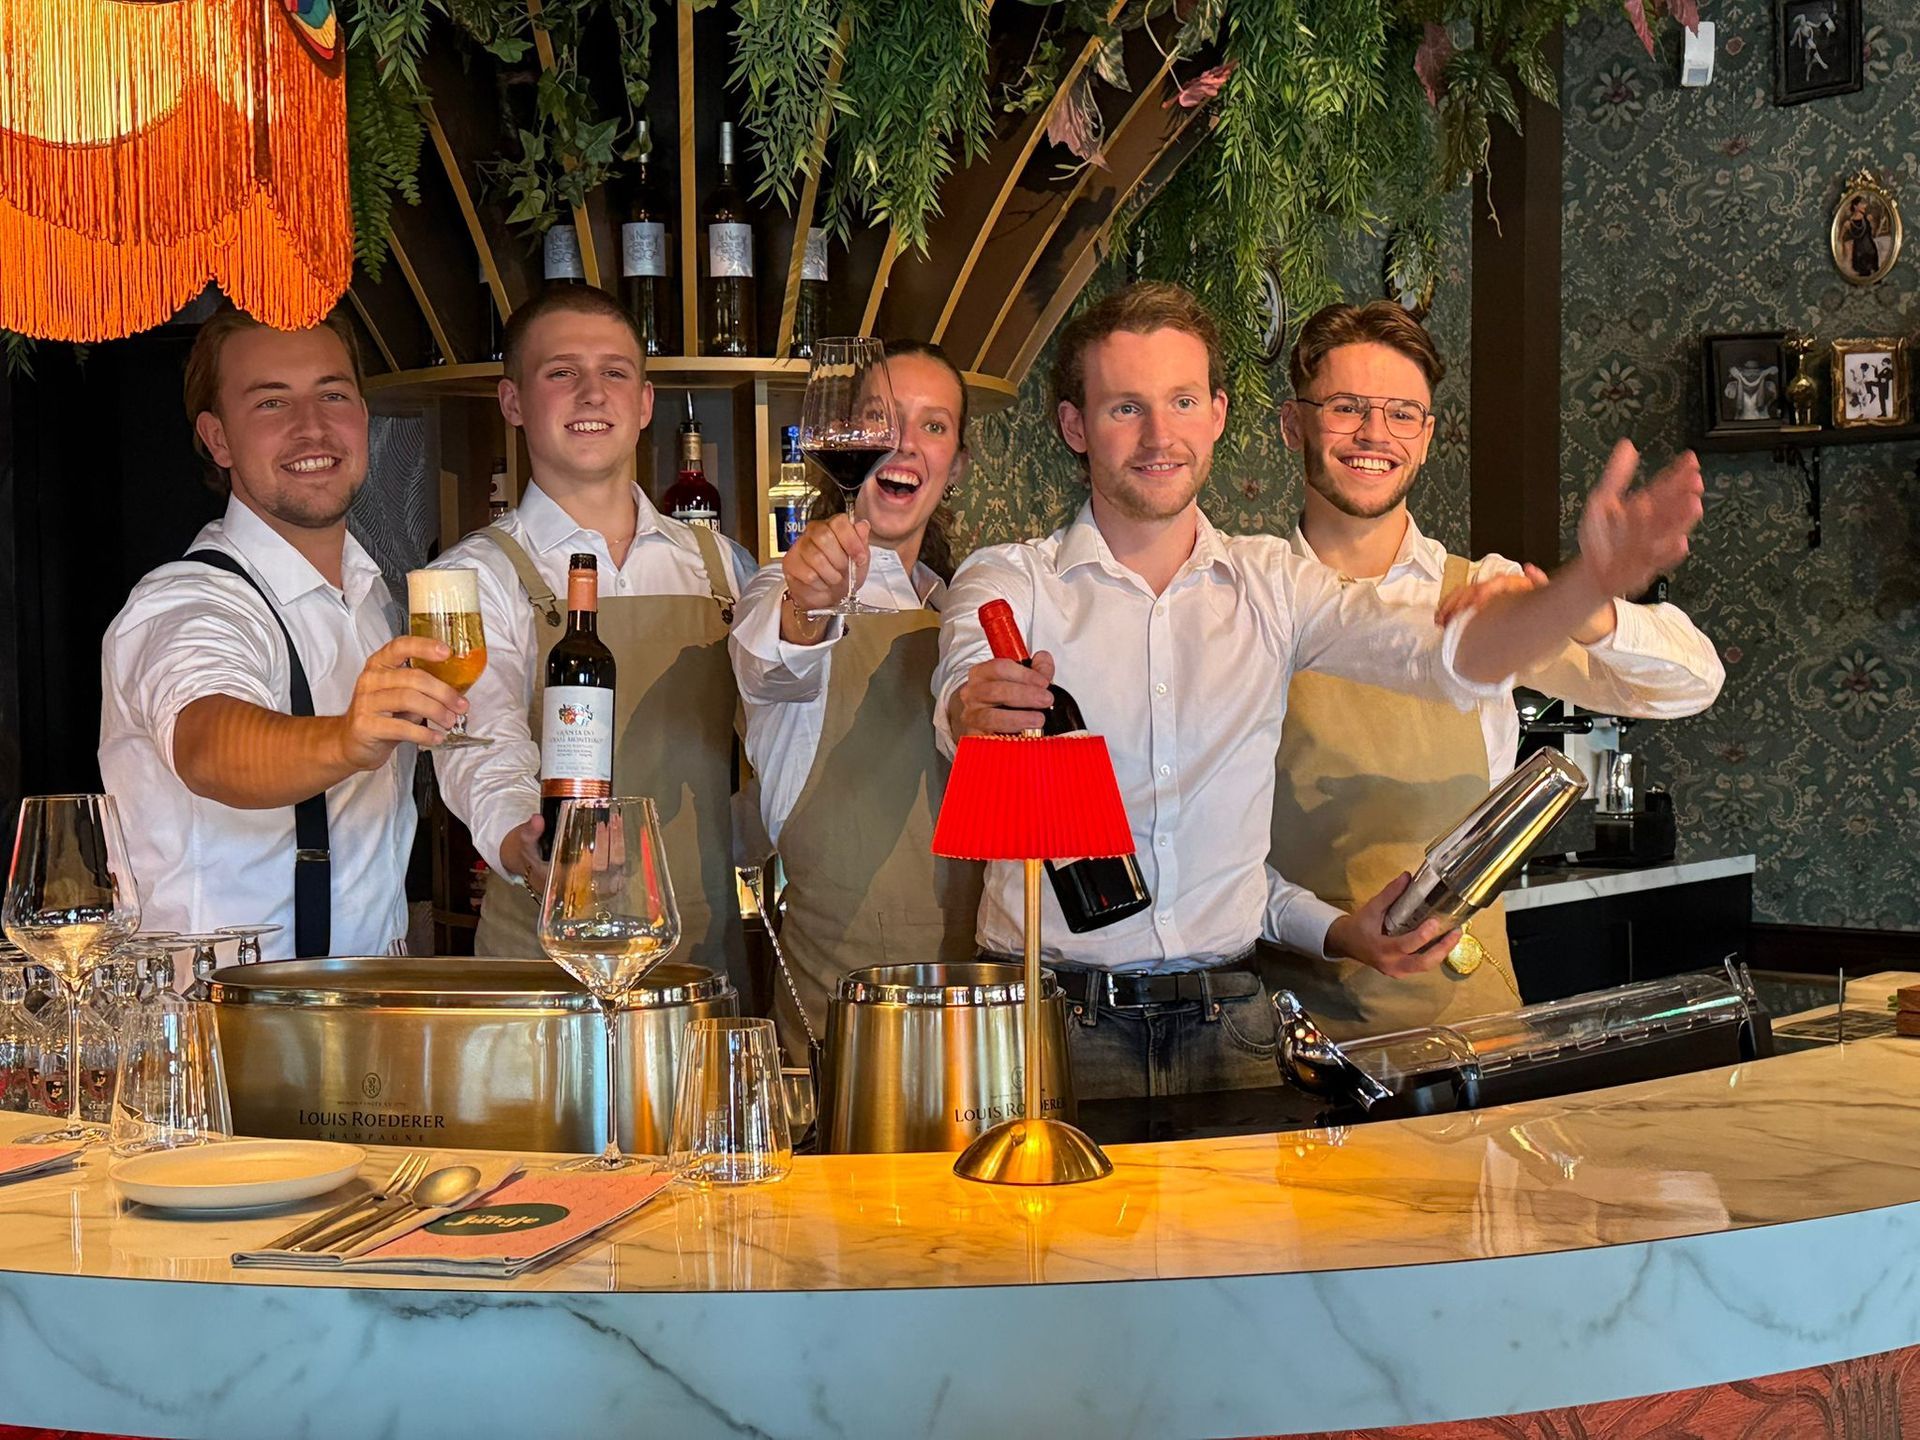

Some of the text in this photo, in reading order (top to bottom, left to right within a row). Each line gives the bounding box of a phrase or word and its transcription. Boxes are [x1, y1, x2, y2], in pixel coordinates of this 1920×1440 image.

[299, 1109, 445, 1129] LOUIS ROEDERER
[955, 1106, 1002, 1122] LOUIS
[318, 1132, 425, 1142] CHAMPAGNE
